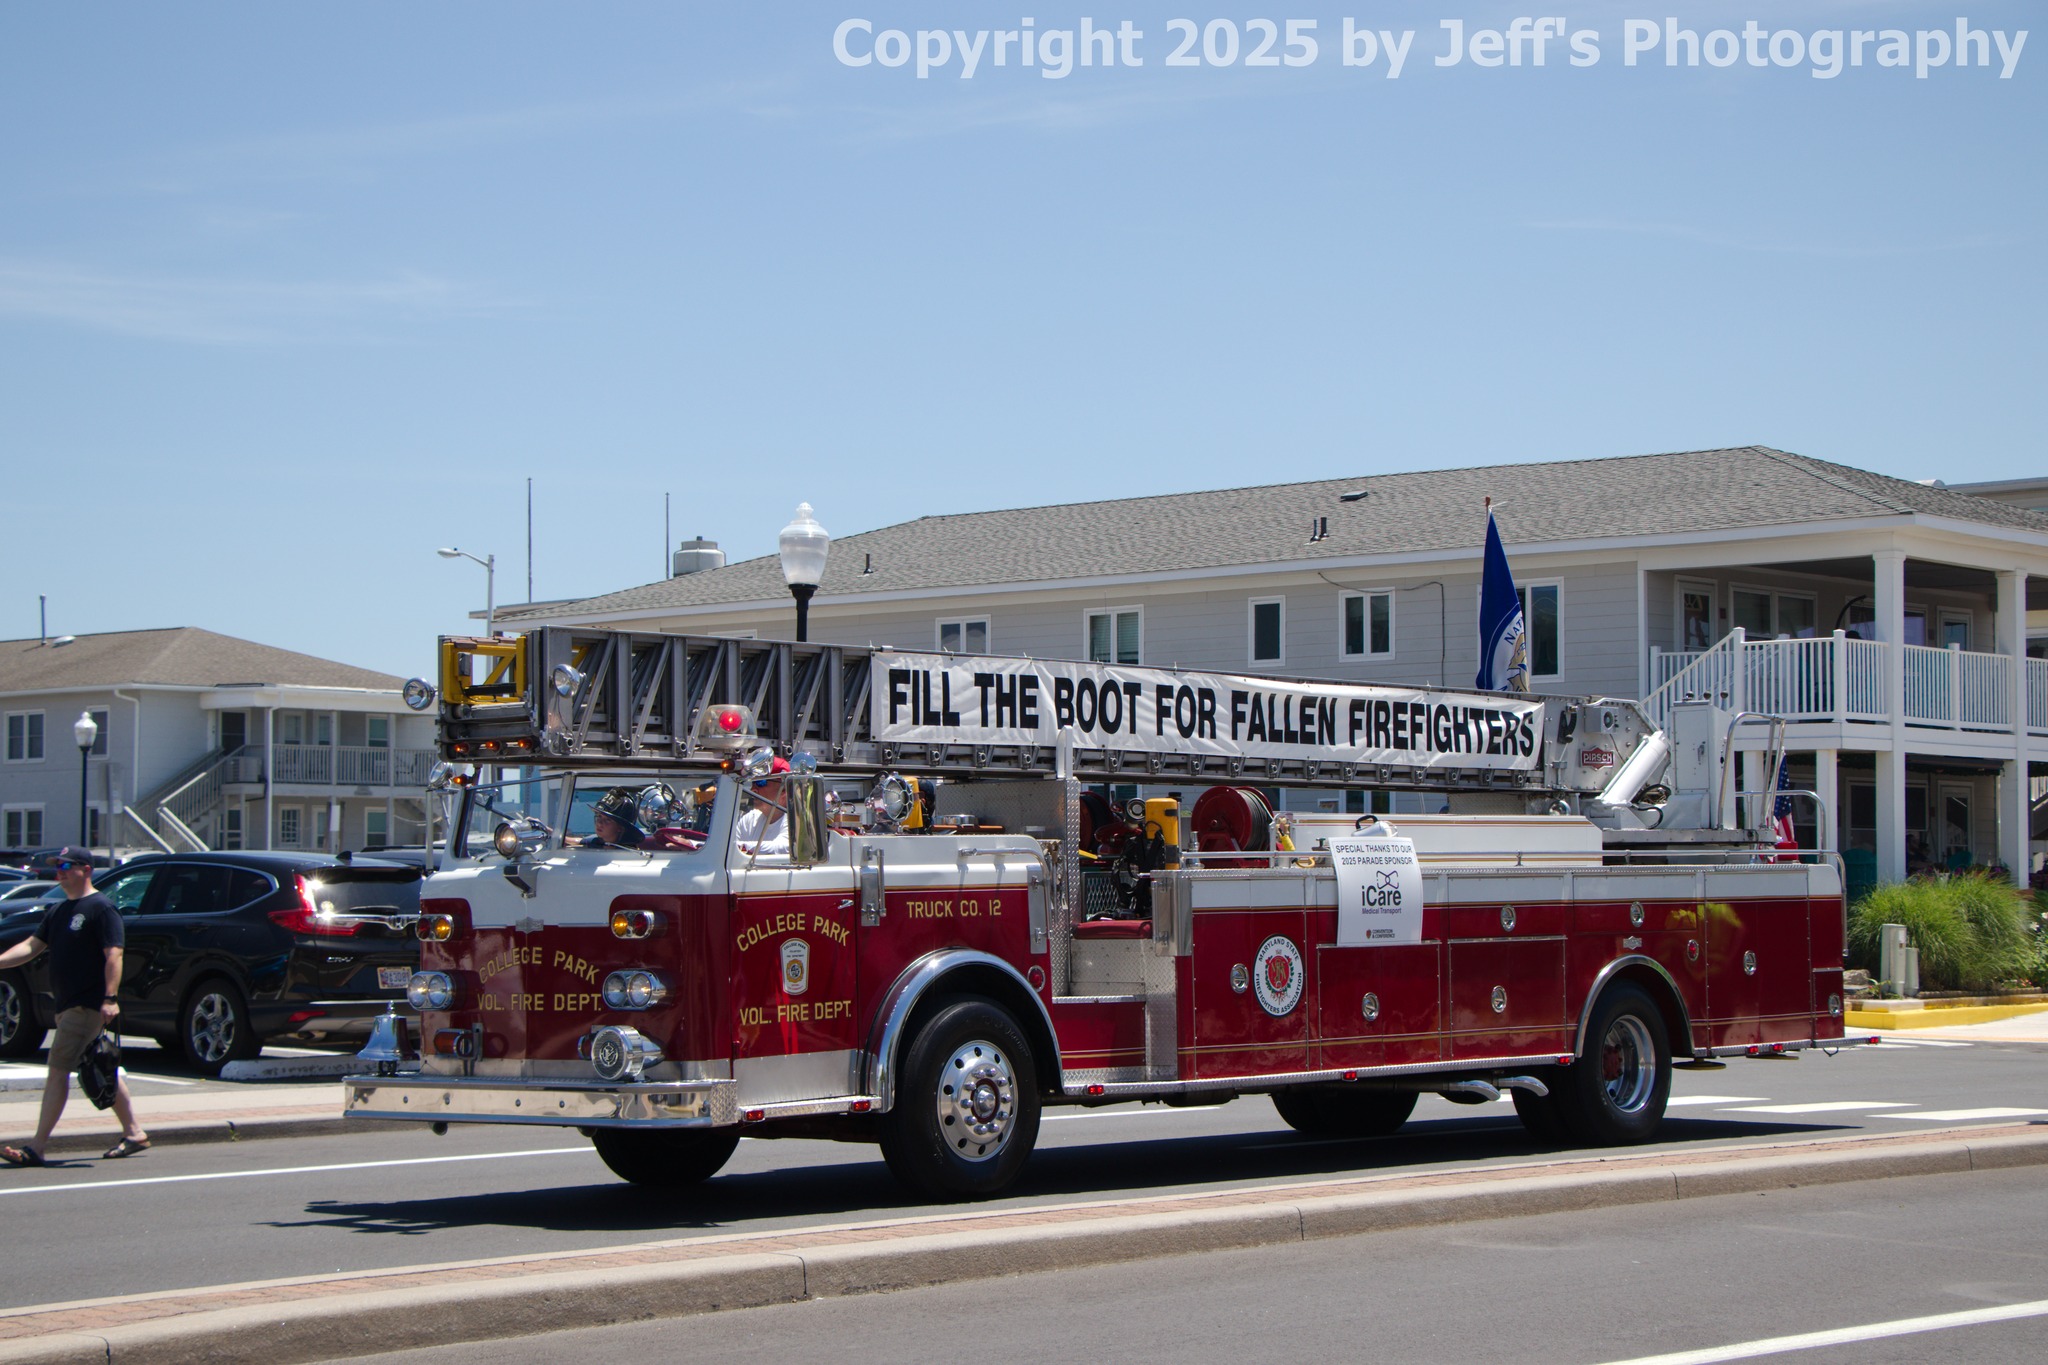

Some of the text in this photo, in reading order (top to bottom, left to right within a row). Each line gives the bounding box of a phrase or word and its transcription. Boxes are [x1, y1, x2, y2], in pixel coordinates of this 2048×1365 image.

[1503, 616, 1524, 646] NAT
[888, 668, 1534, 757] FILL THE BOOT FOR FALLEN FIREFIGHTERS
[1583, 752, 1612, 763] PIRSCH
[1335, 844, 1413, 853] SPECIAL THANKS TO OUR
[1341, 857, 1413, 865] 2025 PARADE SPONSOR
[1361, 885, 1401, 906] iCare
[906, 899, 1002, 919] TRUCK CO. 12
[1362, 907, 1402, 916] Medical Transport
[736, 913, 850, 952] COLLEGE PARK
[1258, 938, 1300, 962] MARYLAND STATE
[478, 947, 600, 985] COLLEGE PARK
[477, 993, 602, 1011] VOL. FIRE DEPT.
[1255, 972, 1302, 1014] FIREFIGHTERS ASSOCIATION
[739, 1000, 852, 1026] VOL. FIRE DEPT.
